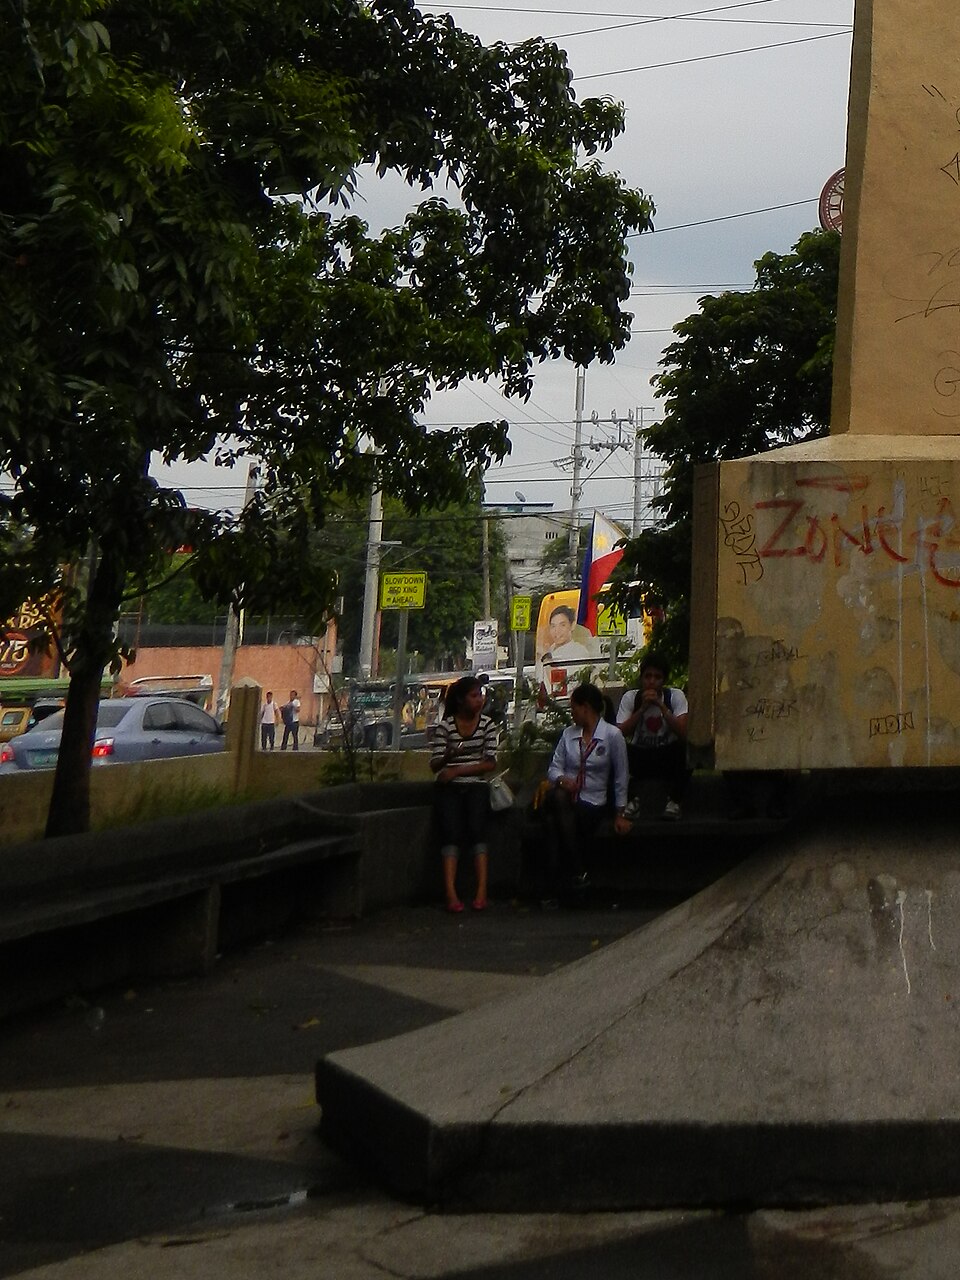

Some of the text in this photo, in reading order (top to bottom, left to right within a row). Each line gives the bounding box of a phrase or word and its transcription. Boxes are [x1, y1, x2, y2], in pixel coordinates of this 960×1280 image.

[385, 576, 424, 585] SLOW DOWN
[403, 586, 418, 594] XING
